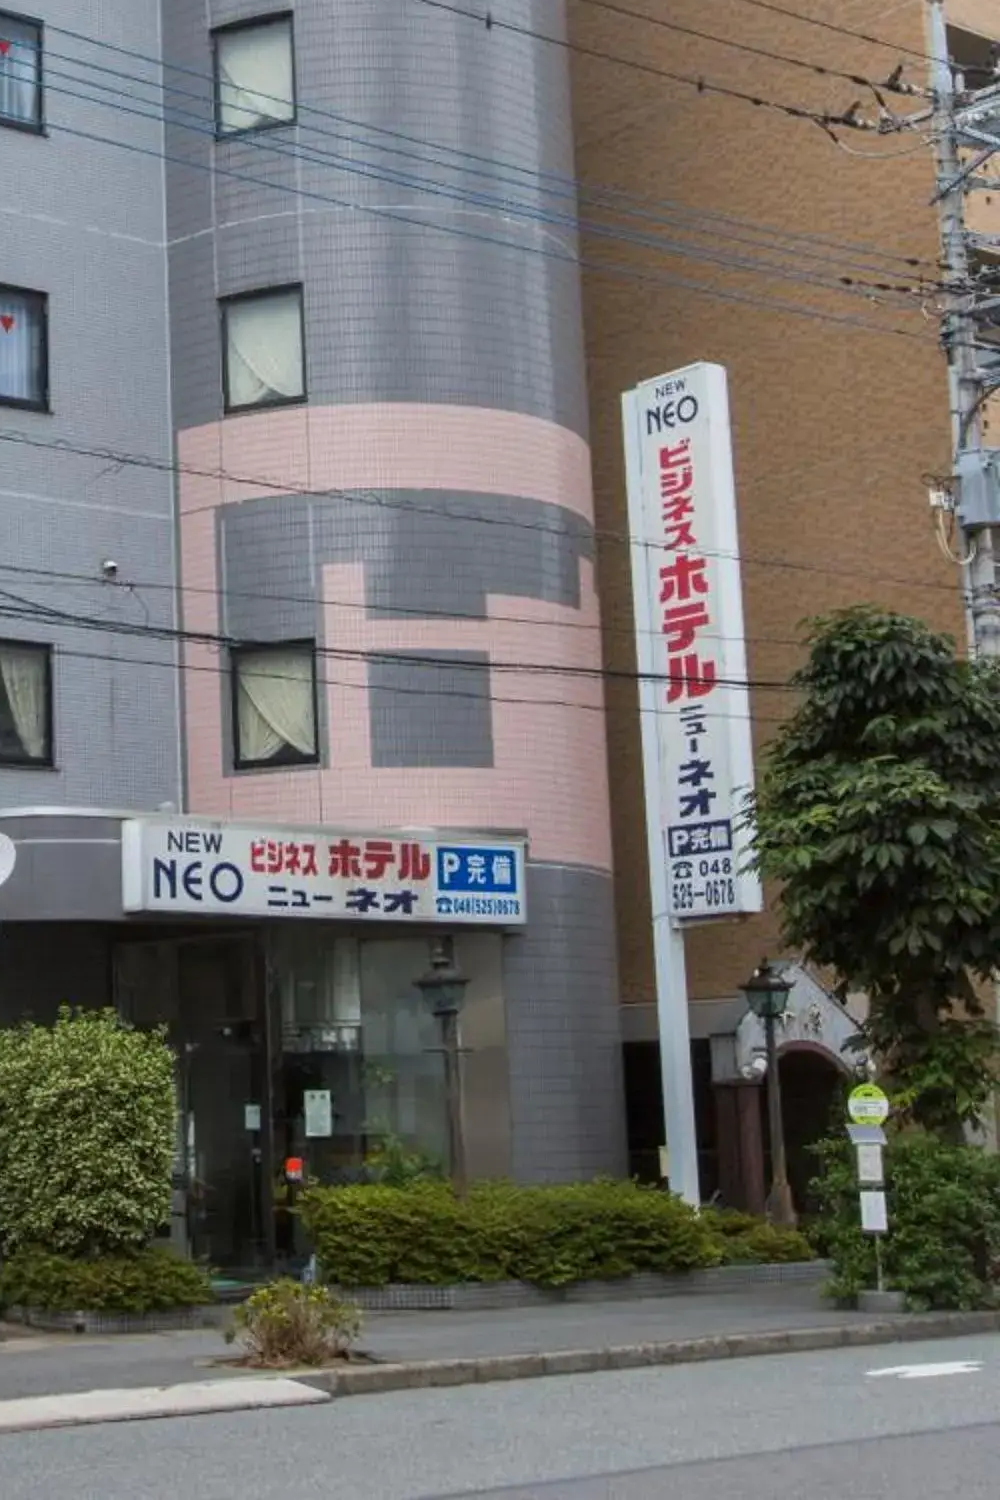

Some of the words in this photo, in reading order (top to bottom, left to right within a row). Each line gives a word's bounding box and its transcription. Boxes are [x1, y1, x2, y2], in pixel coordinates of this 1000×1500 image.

[655, 377, 687, 399] NEW
[646, 395, 698, 434] NEO
[167, 830, 223, 854] NEW
[699, 857, 732, 877] 048
[153, 857, 244, 903] NEO
